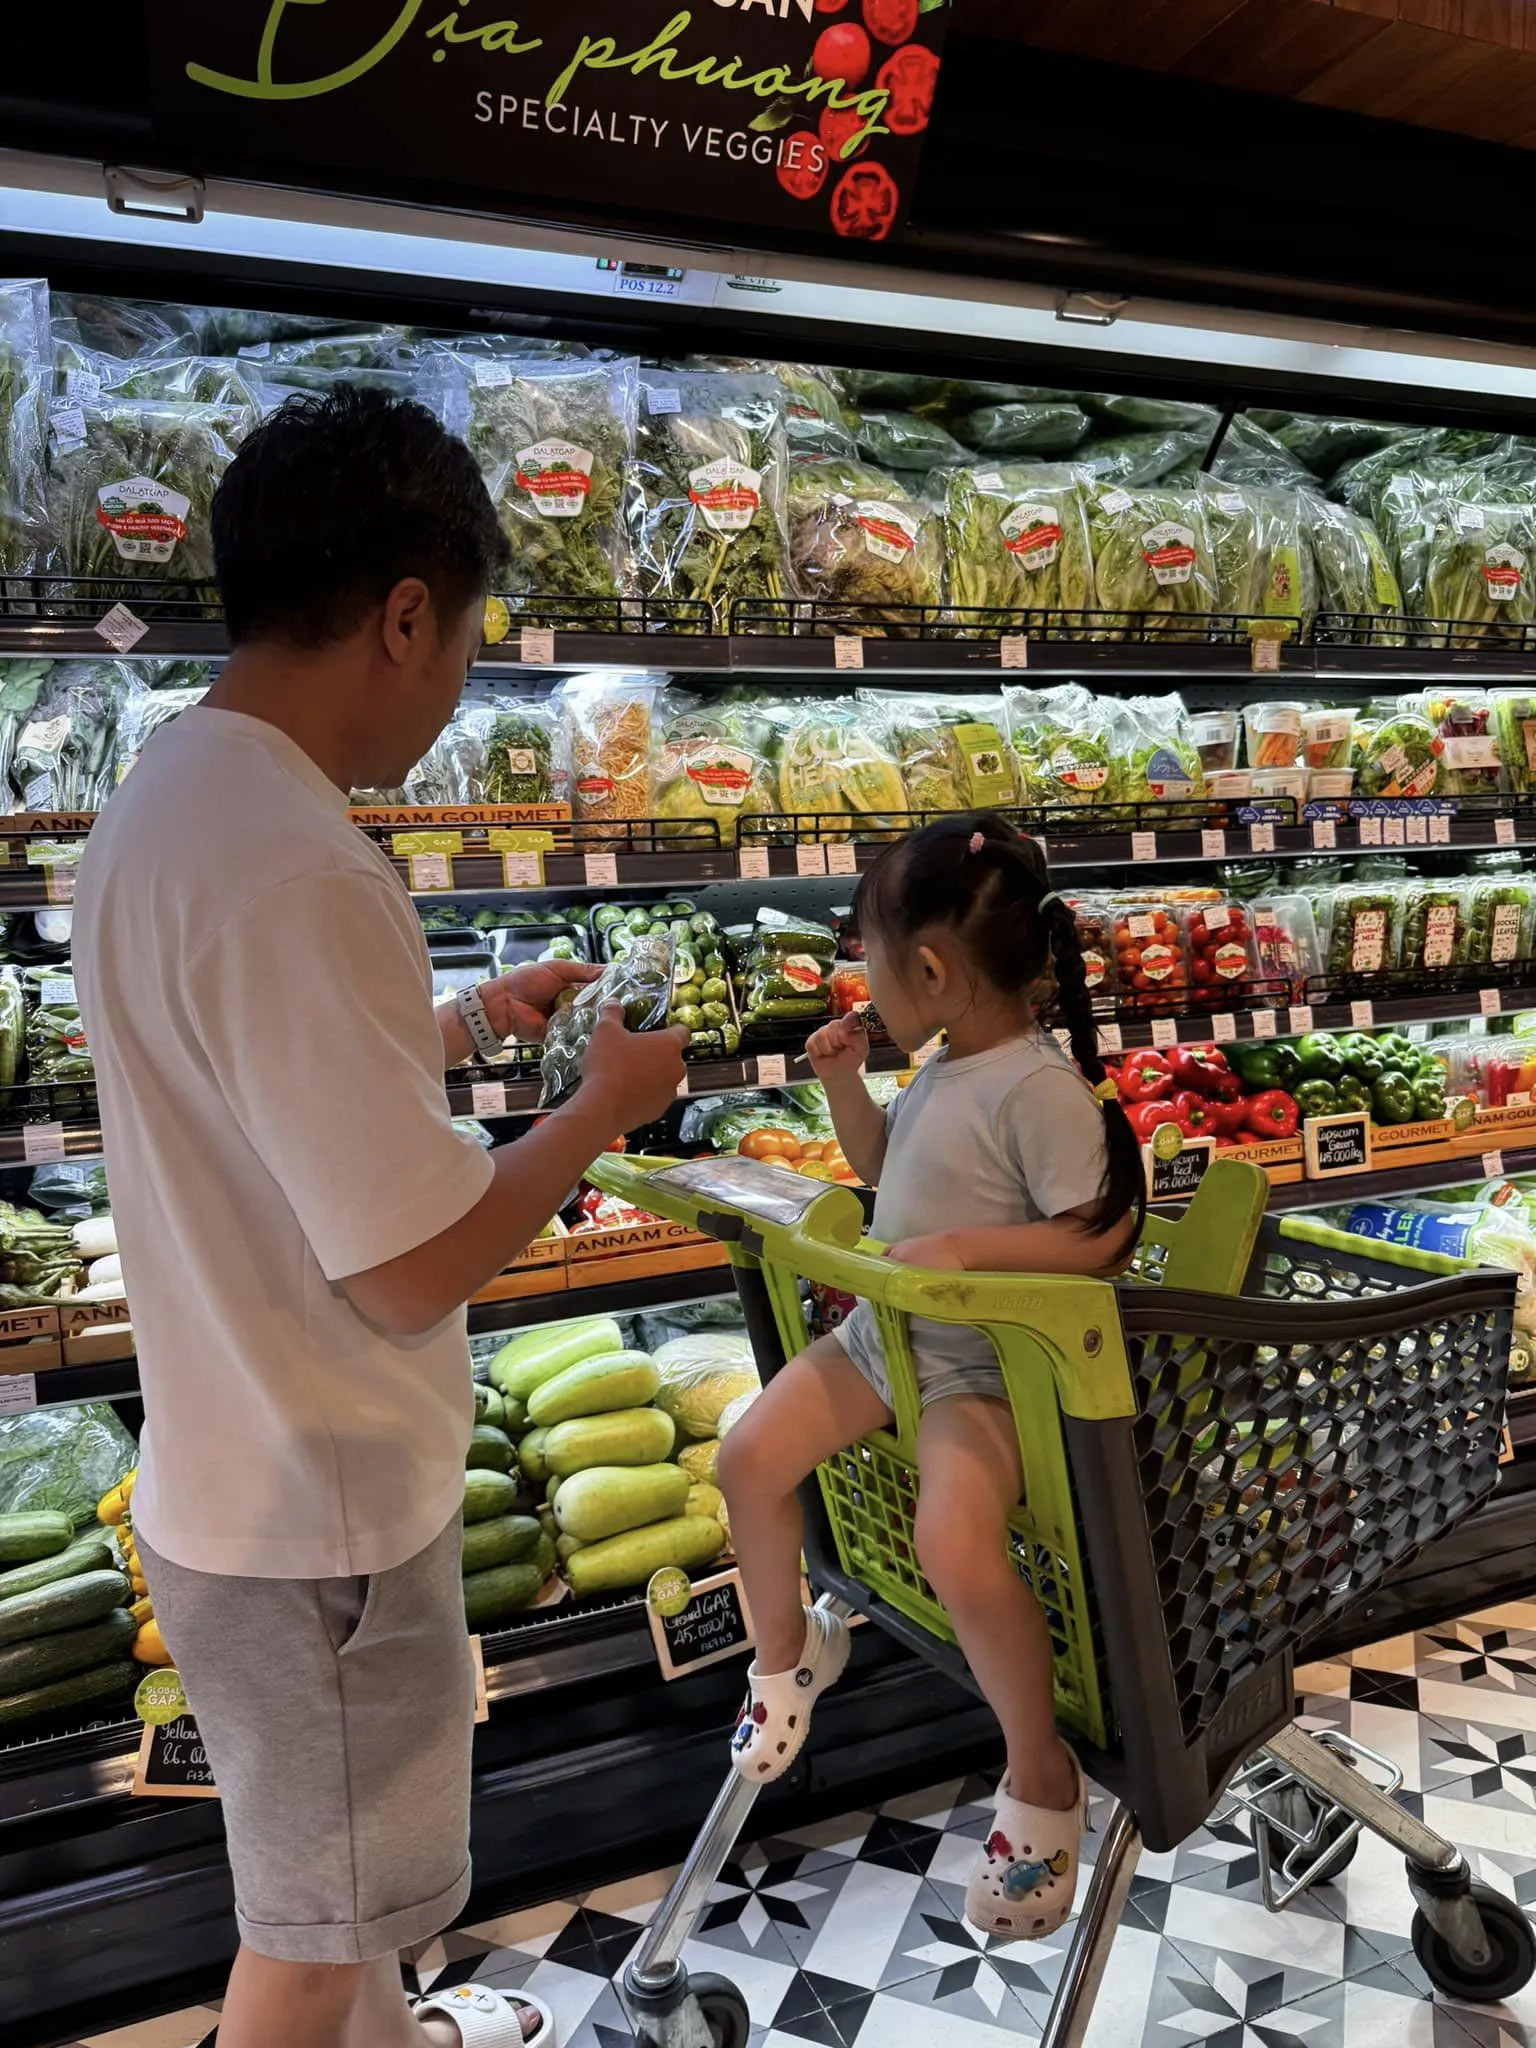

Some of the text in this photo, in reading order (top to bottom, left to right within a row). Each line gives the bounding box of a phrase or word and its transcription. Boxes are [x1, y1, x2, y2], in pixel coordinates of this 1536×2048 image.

[474, 91, 825, 173] SPECIALTY VEGGIES
[619, 279, 674, 295] POS 12.2
[439, 808, 567, 823] GOURMET
[1318, 1126, 1360, 1143] Capsicum
[1377, 1122, 1451, 1143] GOURMET
[575, 1229, 661, 1253] ANNAM
[657, 1584, 681, 1601] GAP
[145, 1686, 181, 1694] GLOBAL
[147, 1694, 178, 1705] GAP
